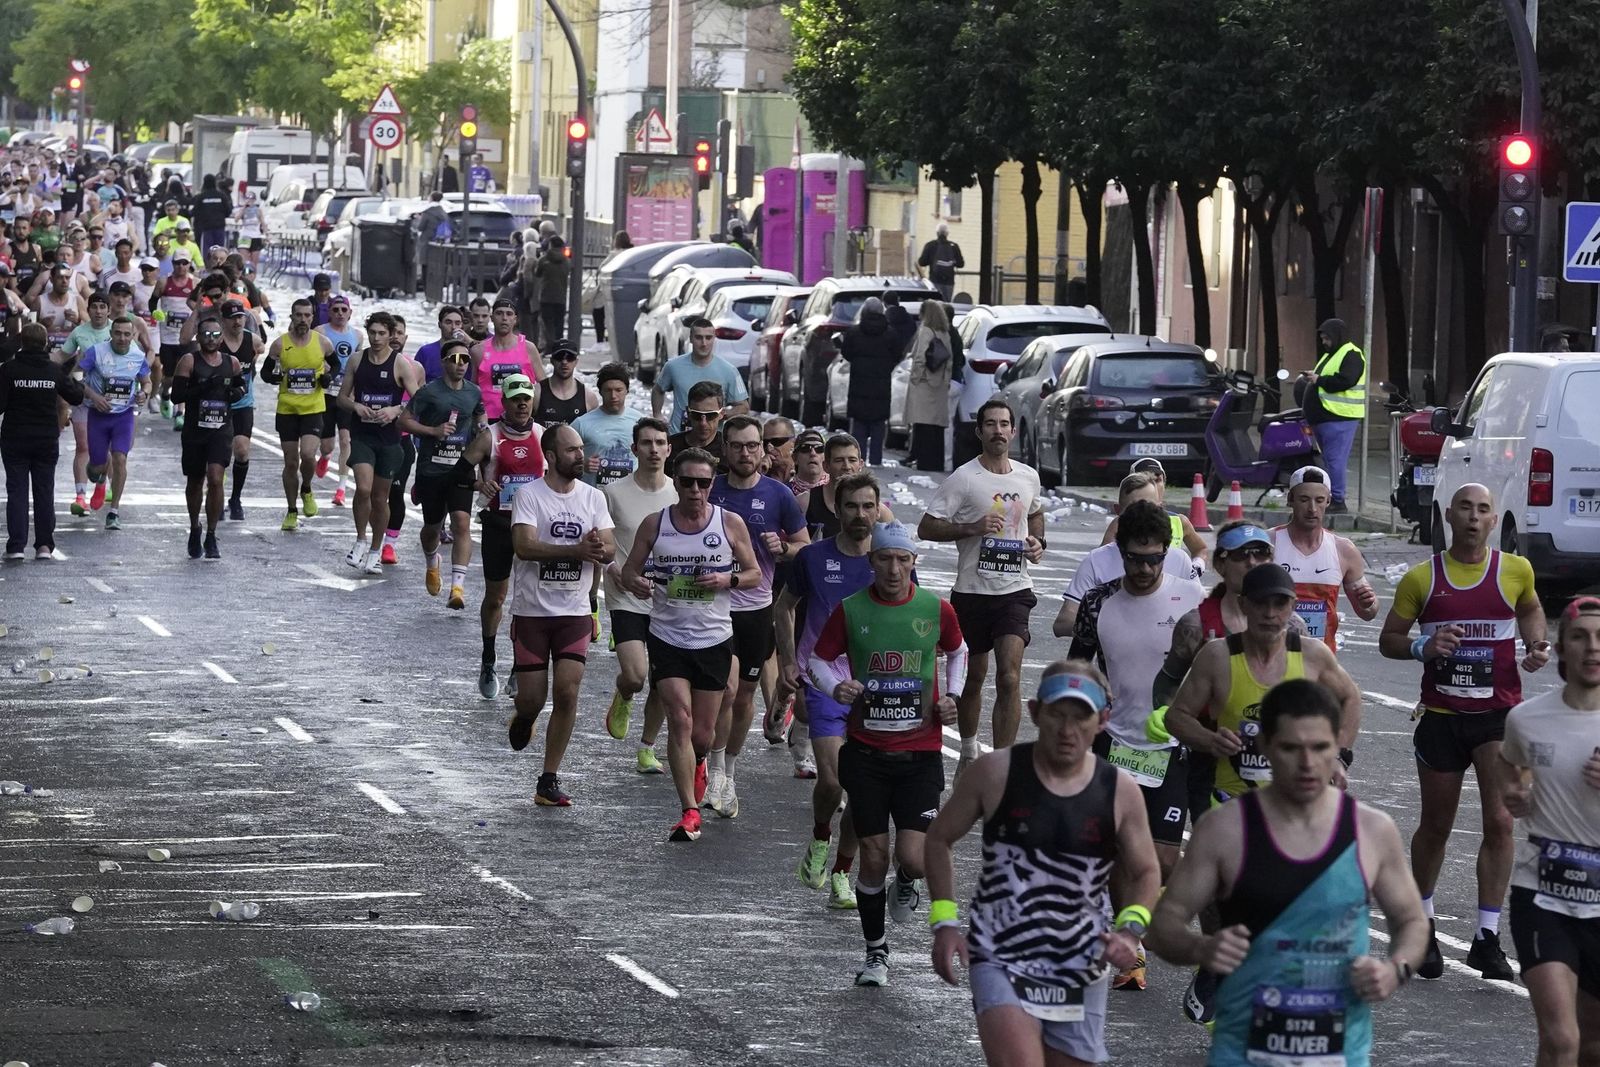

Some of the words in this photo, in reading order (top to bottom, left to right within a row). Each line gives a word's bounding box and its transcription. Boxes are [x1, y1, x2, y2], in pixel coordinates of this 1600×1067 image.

[376, 127, 396, 138] 30
[14, 380, 55, 389] VOLUNTEER
[1137, 444, 1163, 454] 4249
[1165, 444, 1185, 455] GBR
[1285, 440, 1302, 448] cabify
[438, 450, 462, 458] RAMÓN
[997, 541, 1020, 549] ZURICH
[659, 555, 707, 564] Edinburgh
[709, 554, 722, 563] AC
[979, 560, 996, 570] TONI
[998, 562, 1003, 571] Y
[543, 570, 580, 580] ALFONSO
[677, 588, 705, 599] STEVE
[868, 650, 922, 673] ADN
[1455, 664, 1473, 673] 4812
[882, 681, 915, 690] ZURICH
[1451, 674, 1476, 686] NEIL
[869, 707, 916, 719] MARCOS
[1108, 754, 1140, 771] DANIEL
[1024, 985, 1067, 1003] DAVID
[1286, 993, 1336, 1007] ZURICH
[1266, 1034, 1329, 1054] OLIVER
